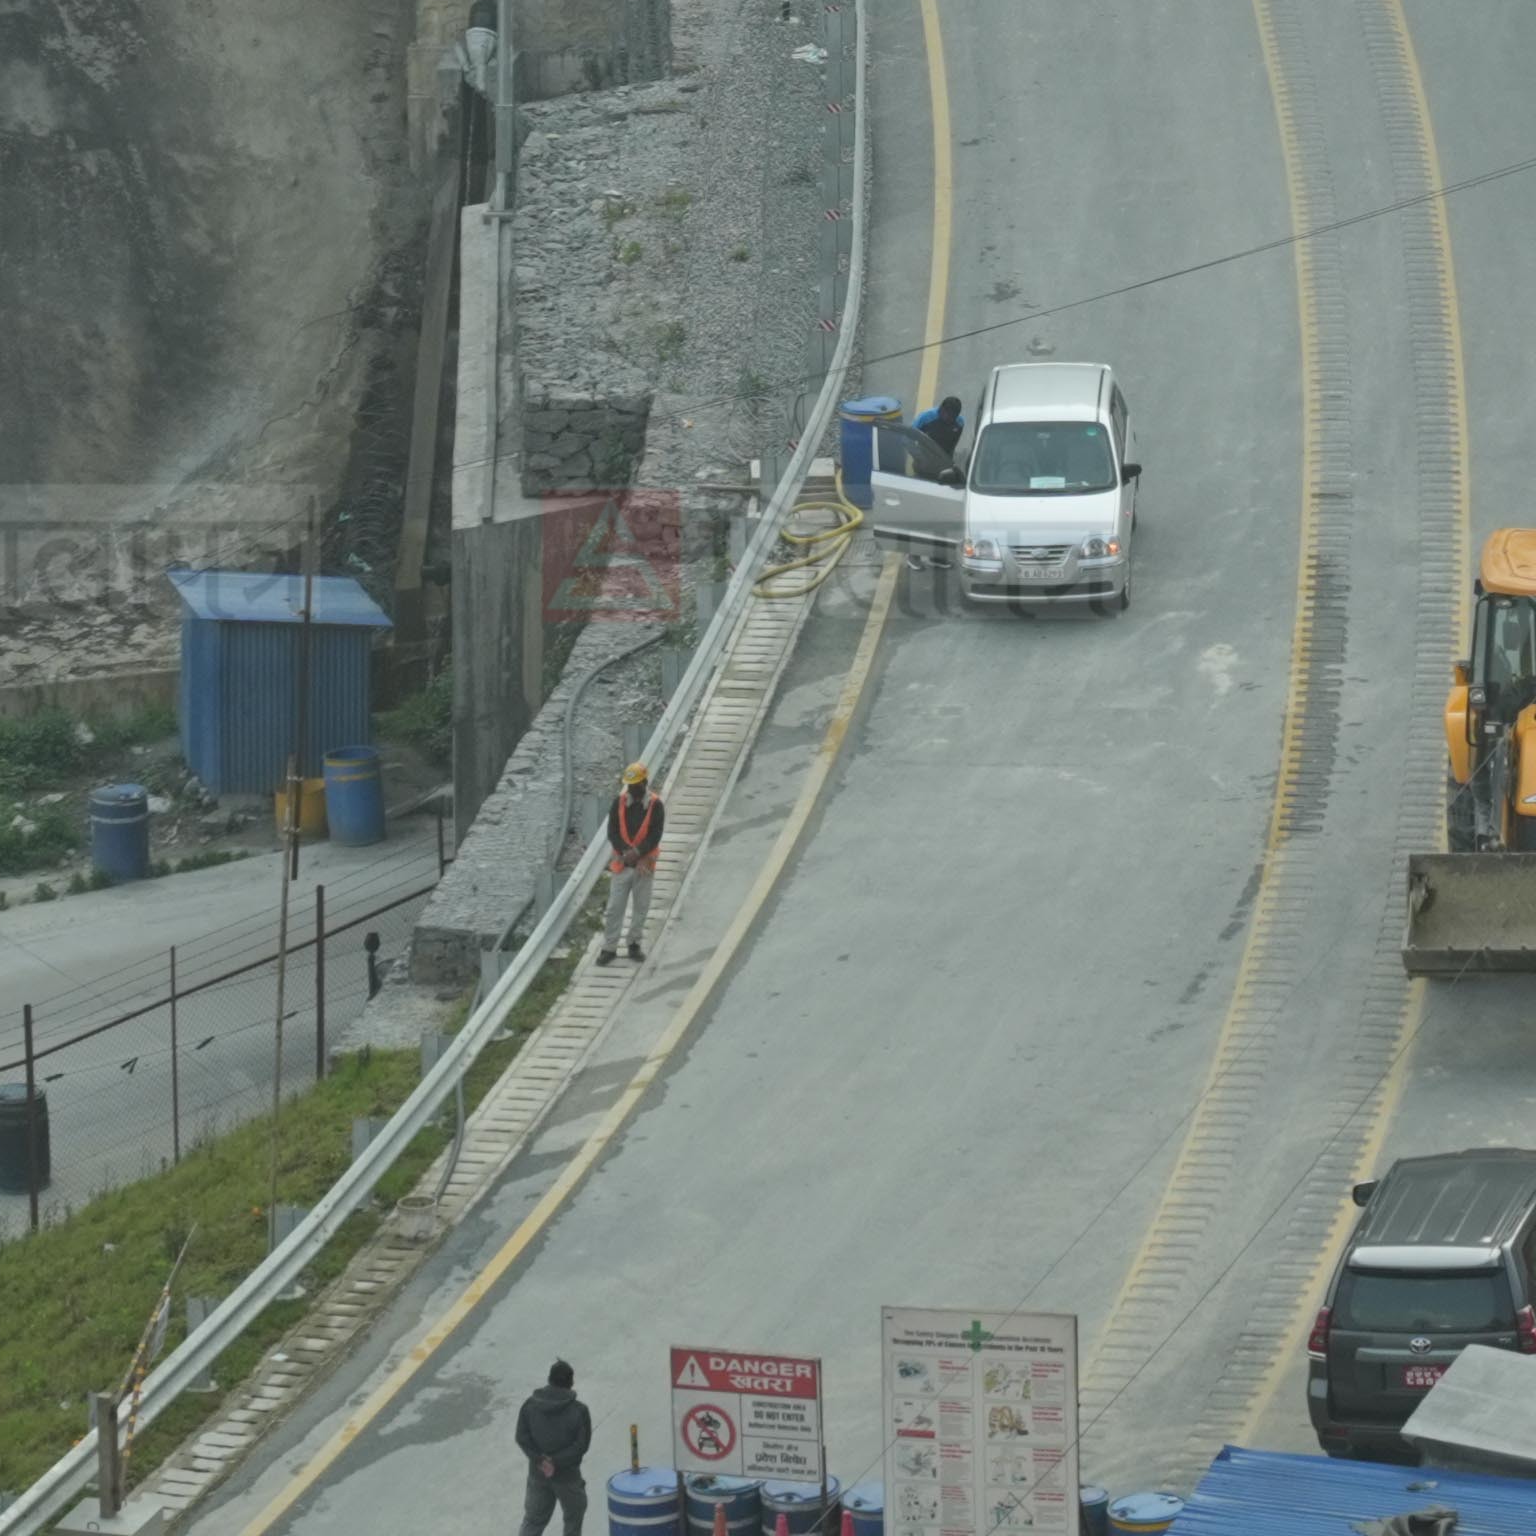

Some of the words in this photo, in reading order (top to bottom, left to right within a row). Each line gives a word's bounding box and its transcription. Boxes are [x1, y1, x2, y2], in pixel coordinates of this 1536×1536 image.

[708, 1356, 813, 1379] DANGER
[728, 1374, 795, 1393] खतरा
[753, 1409, 764, 1420] DO
[765, 1411, 780, 1421] NOT
[781, 1412, 806, 1423] ENTER
